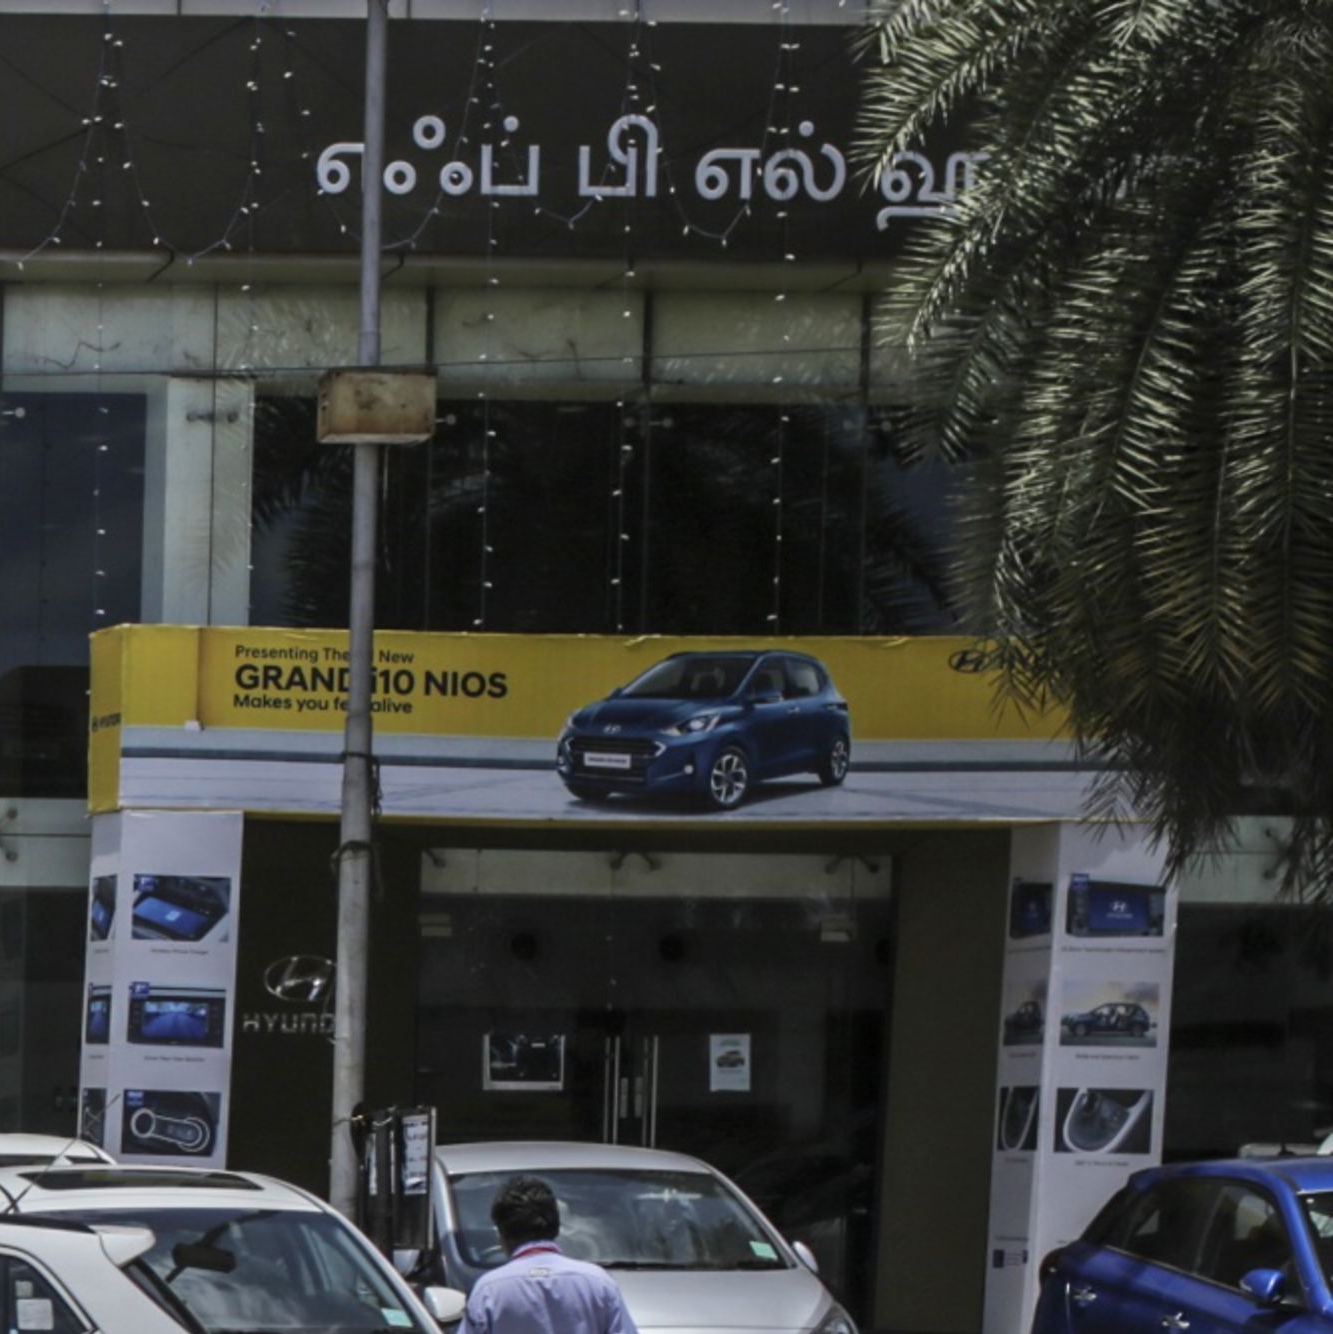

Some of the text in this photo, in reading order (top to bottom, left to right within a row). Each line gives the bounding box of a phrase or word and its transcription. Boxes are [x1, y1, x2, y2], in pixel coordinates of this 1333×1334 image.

[579, 114, 658, 198] பி
[695, 120, 846, 199] எல்
[235, 645, 318, 662] Presenting
[323, 647, 349, 661] The
[378, 650, 414, 663] New
[424, 670, 508, 698] NIOS
[233, 694, 292, 711] Makes
[296, 698, 328, 713] you
[371, 698, 413, 714] alive
[243, 1013, 336, 1033] HYUND
